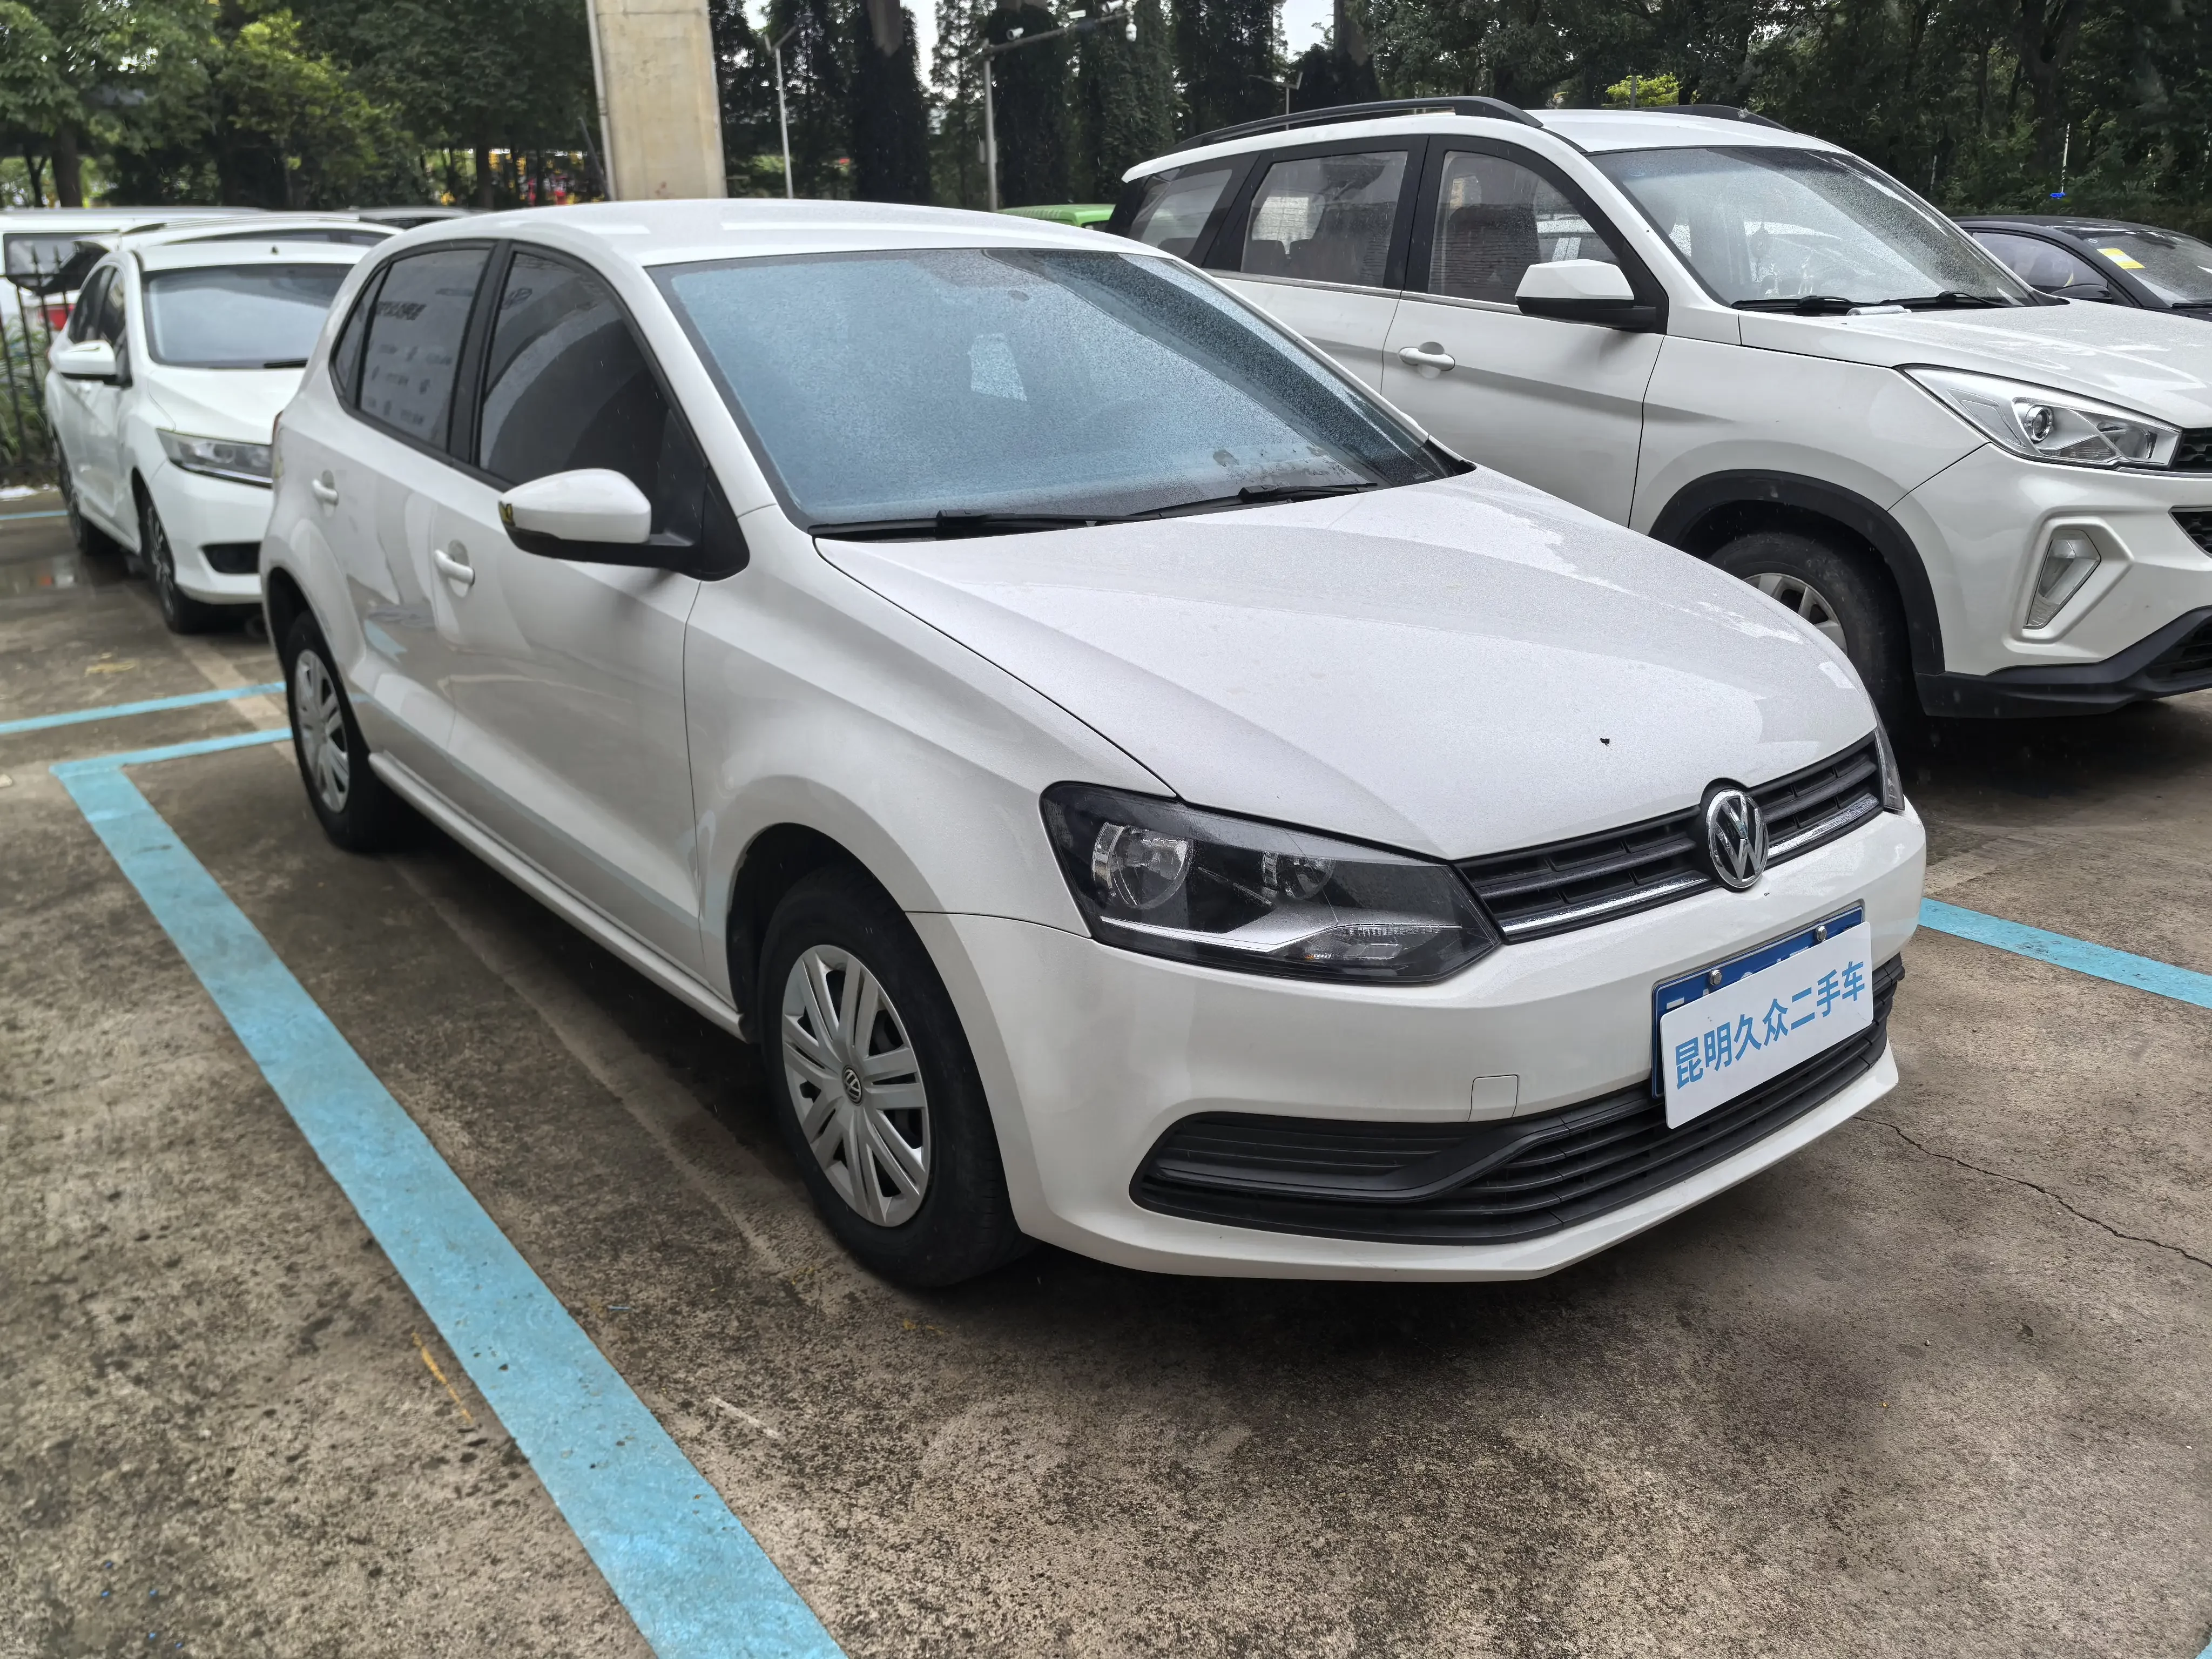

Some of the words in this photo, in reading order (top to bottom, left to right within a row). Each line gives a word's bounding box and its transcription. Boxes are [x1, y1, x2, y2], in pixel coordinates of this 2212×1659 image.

[1707, 789, 1769, 888] VW
[1675, 961, 1865, 1089] 昆明久众二手车
